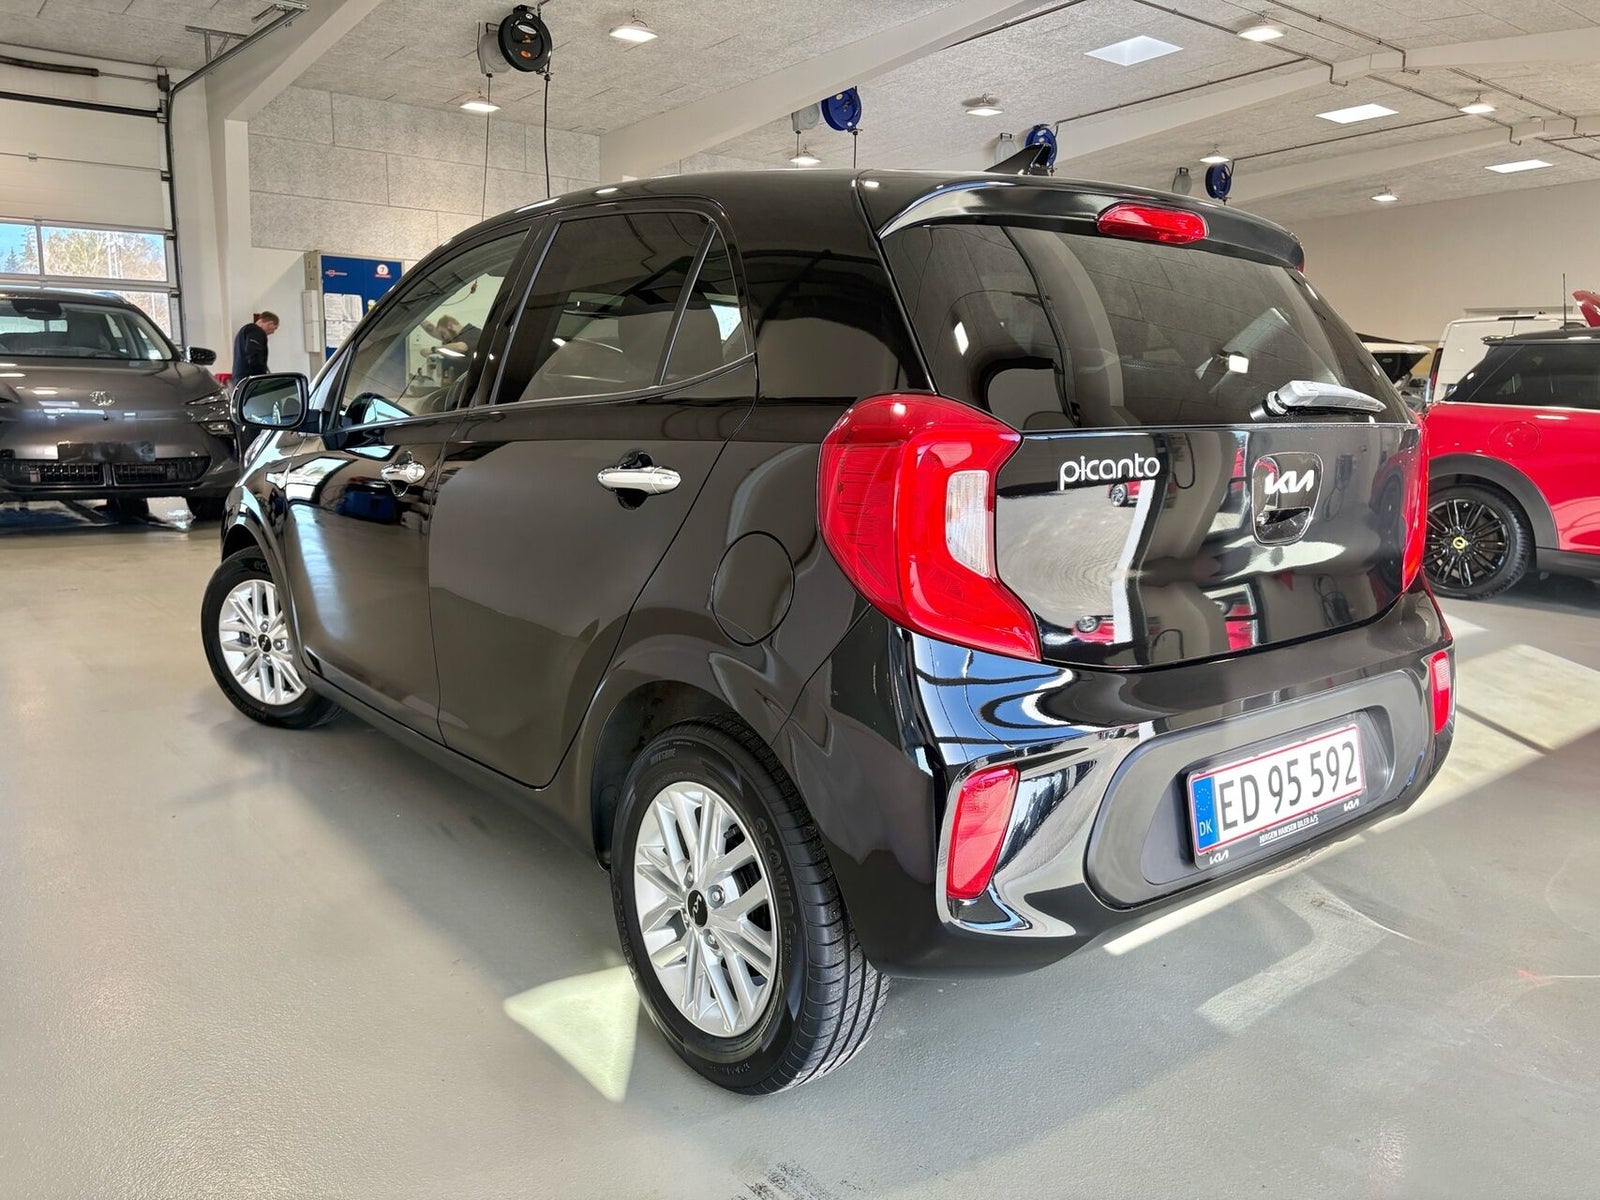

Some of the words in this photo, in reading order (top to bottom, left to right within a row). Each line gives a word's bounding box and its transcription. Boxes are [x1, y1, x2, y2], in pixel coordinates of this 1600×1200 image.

[1059, 453, 1161, 491] picanto
[1264, 470, 1315, 494] KIA
[1219, 774, 1260, 831] ED
[1268, 758, 1302, 815] 95
[1310, 741, 1358, 798] 592
[1199, 819, 1213, 837] DK
